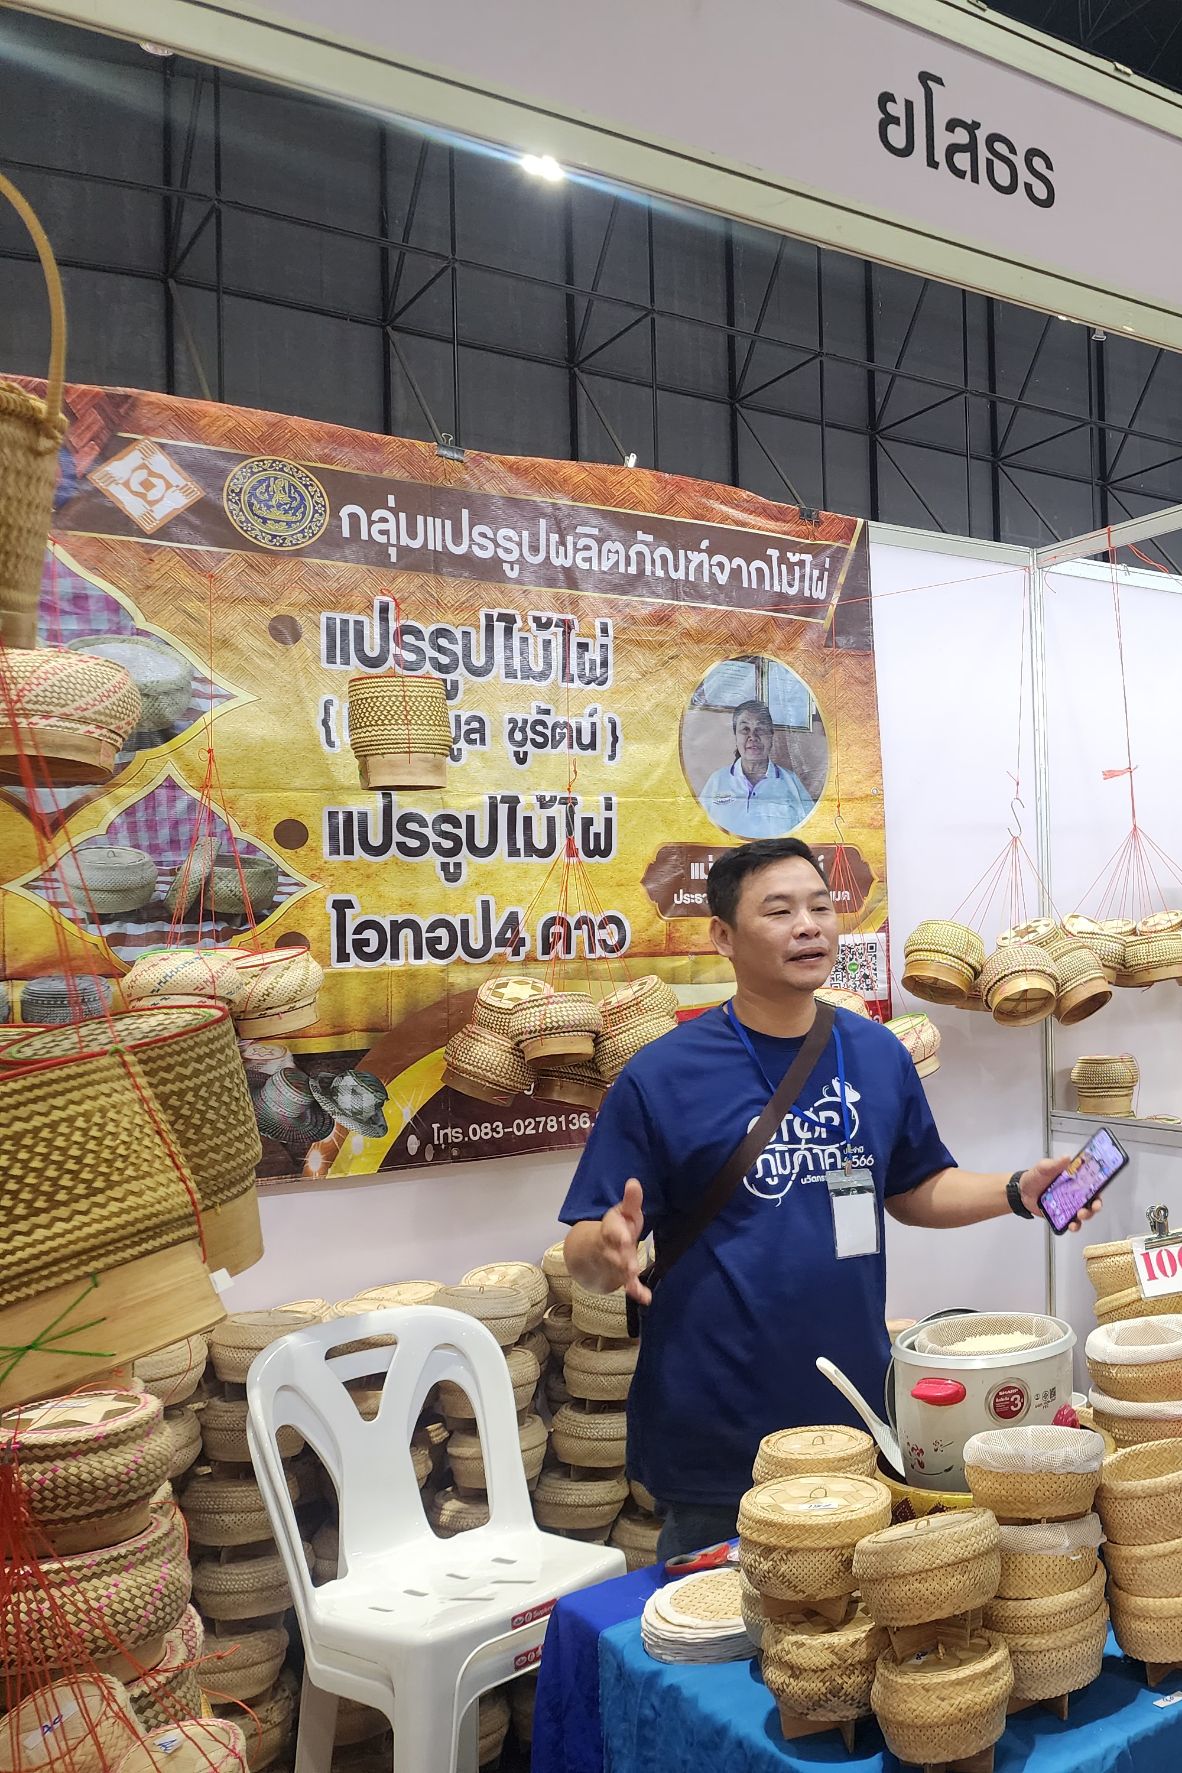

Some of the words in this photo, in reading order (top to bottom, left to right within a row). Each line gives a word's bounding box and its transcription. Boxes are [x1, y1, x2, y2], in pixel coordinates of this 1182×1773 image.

[877, 70, 1056, 209] ยโสธร
[338, 495, 831, 601] กลุ่มแปรรูปผลิตภัณฑ์จากไม้ไผ่
[324, 600, 612, 701] แปรรูปไม้ไผ่
[326, 791, 614, 884] แปรรูปไม้ไผ่
